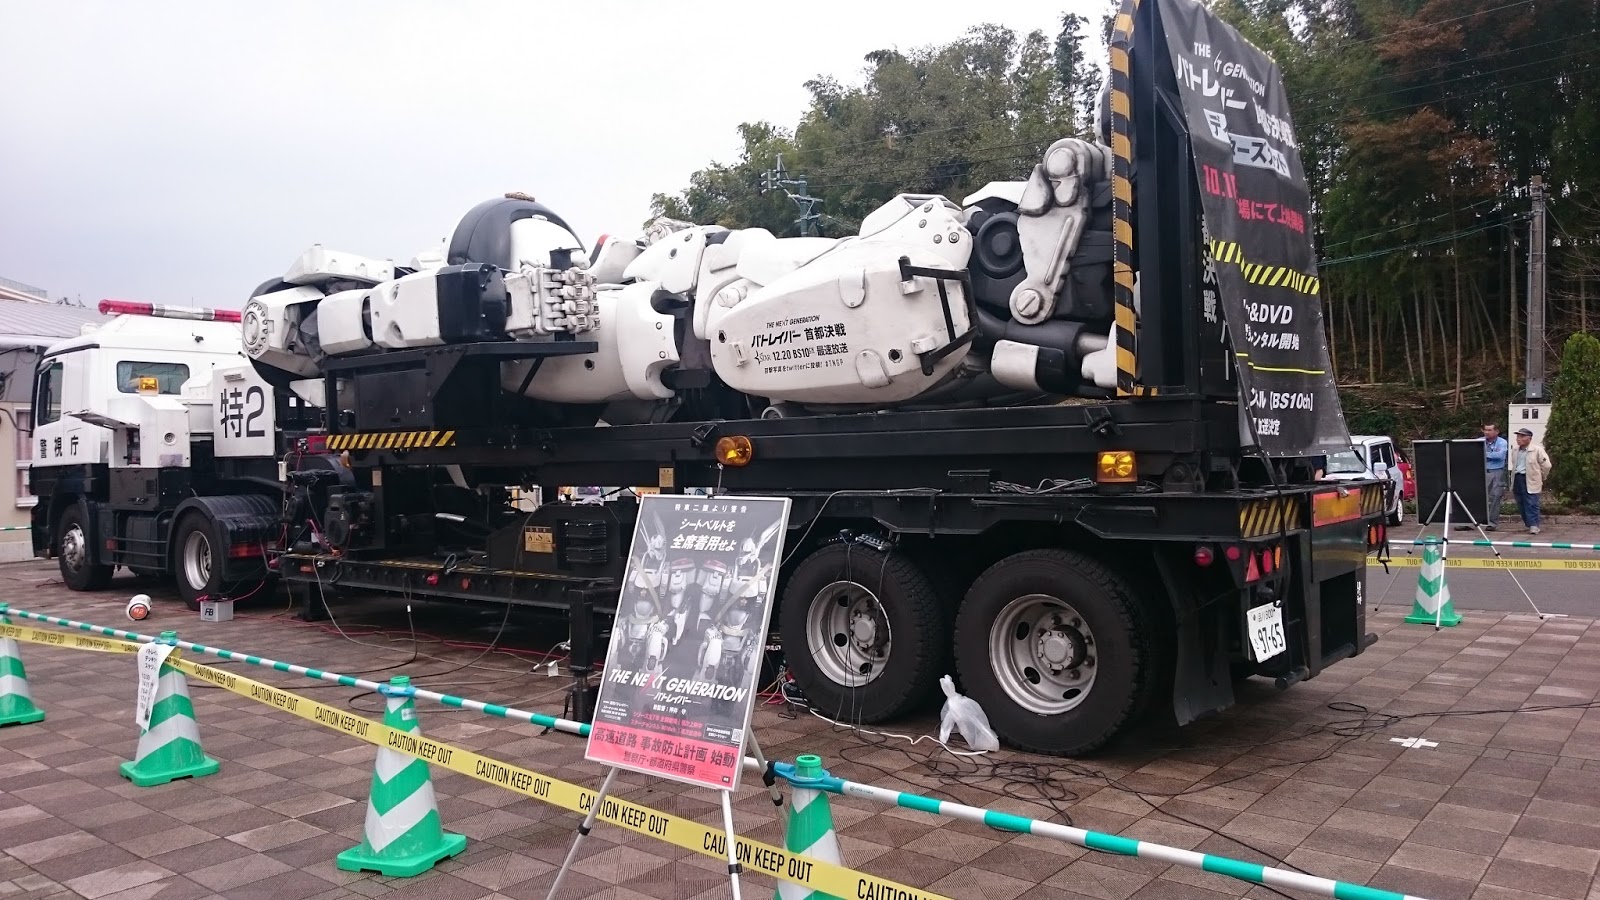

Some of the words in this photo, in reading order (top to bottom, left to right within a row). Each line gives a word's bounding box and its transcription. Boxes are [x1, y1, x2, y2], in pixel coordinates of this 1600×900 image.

[1193, 42, 1211, 58] THE
[789, 315, 821, 326] GENERATION
[751, 330, 802, 348] パトレイバー
[804, 323, 847, 341] 首都決戦
[772, 350, 792, 361] 12.20
[816, 342, 849, 356] 最速放送
[679, 519, 736, 532] シートベルトを
[670, 534, 737, 551] 全席着用せよ
[194, 665, 214, 681] CAUTION
[214, 670, 226, 684] KEEP
[226, 676, 236, 689] OUT
[608, 669, 632, 684] THE
[666, 678, 747, 702] GENERATION
[252, 684, 273, 702] CAUTION
[273, 690, 287, 707] KEEP
[287, 696, 299, 712] OUT
[315, 706, 339, 726] CAUTION
[339, 715, 355, 731] KEEP
[356, 720, 369, 737] OUT
[389, 731, 417, 754] CAUTION
[418, 742, 437, 760] KEEP
[437, 747, 453, 765] OUT
[594, 727, 638, 748] 高速道路
[640, 735, 708, 763] 事故防止計画
[710, 750, 736, 769] 始動
[476, 760, 510, 785] CAUTION
[510, 772, 532, 792] KEEP
[533, 778, 551, 798] OUT
[620, 806, 646, 828] KEEP
[648, 814, 669, 837] OUT
[703, 832, 752, 863] CAUON
[754, 847, 785, 873] KEEP
[788, 858, 813, 882] OUT
